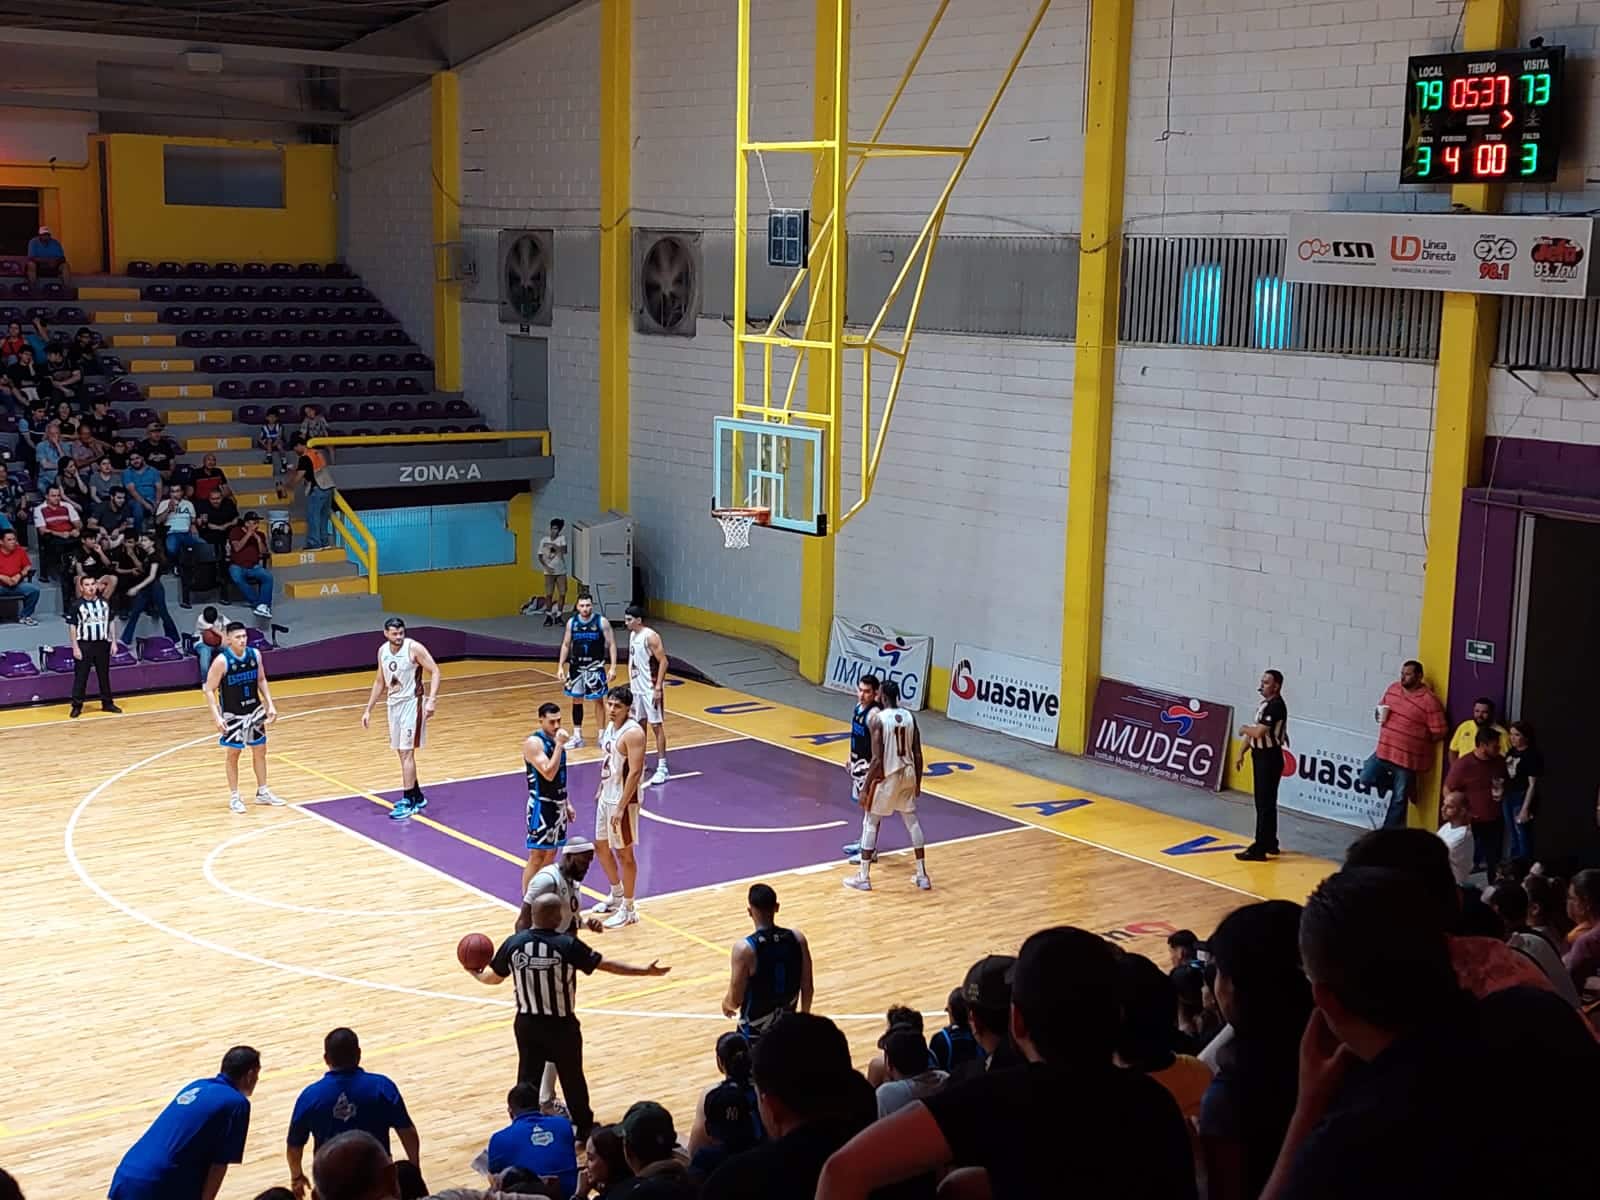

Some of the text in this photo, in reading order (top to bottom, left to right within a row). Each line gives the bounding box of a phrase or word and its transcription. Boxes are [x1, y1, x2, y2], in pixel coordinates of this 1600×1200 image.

[1419, 66, 1443, 78] LOCAL
[1467, 62, 1497, 74] TIEMPO
[1523, 58, 1550, 71] VISITA
[1416, 80, 1443, 111] 79
[1519, 74, 1551, 106] 73
[1417, 146, 1432, 176] 3
[1444, 146, 1460, 174] 4
[1477, 144, 1507, 175] 00
[1520, 143, 1538, 175] 3
[1333, 241, 1375, 259] rsn
[400, 463, 481, 482] ZONA-A
[320, 583, 339, 595] AA
[1096, 719, 1213, 776] IMUDEG
[1352, 795, 1387, 809] JUNTOS
